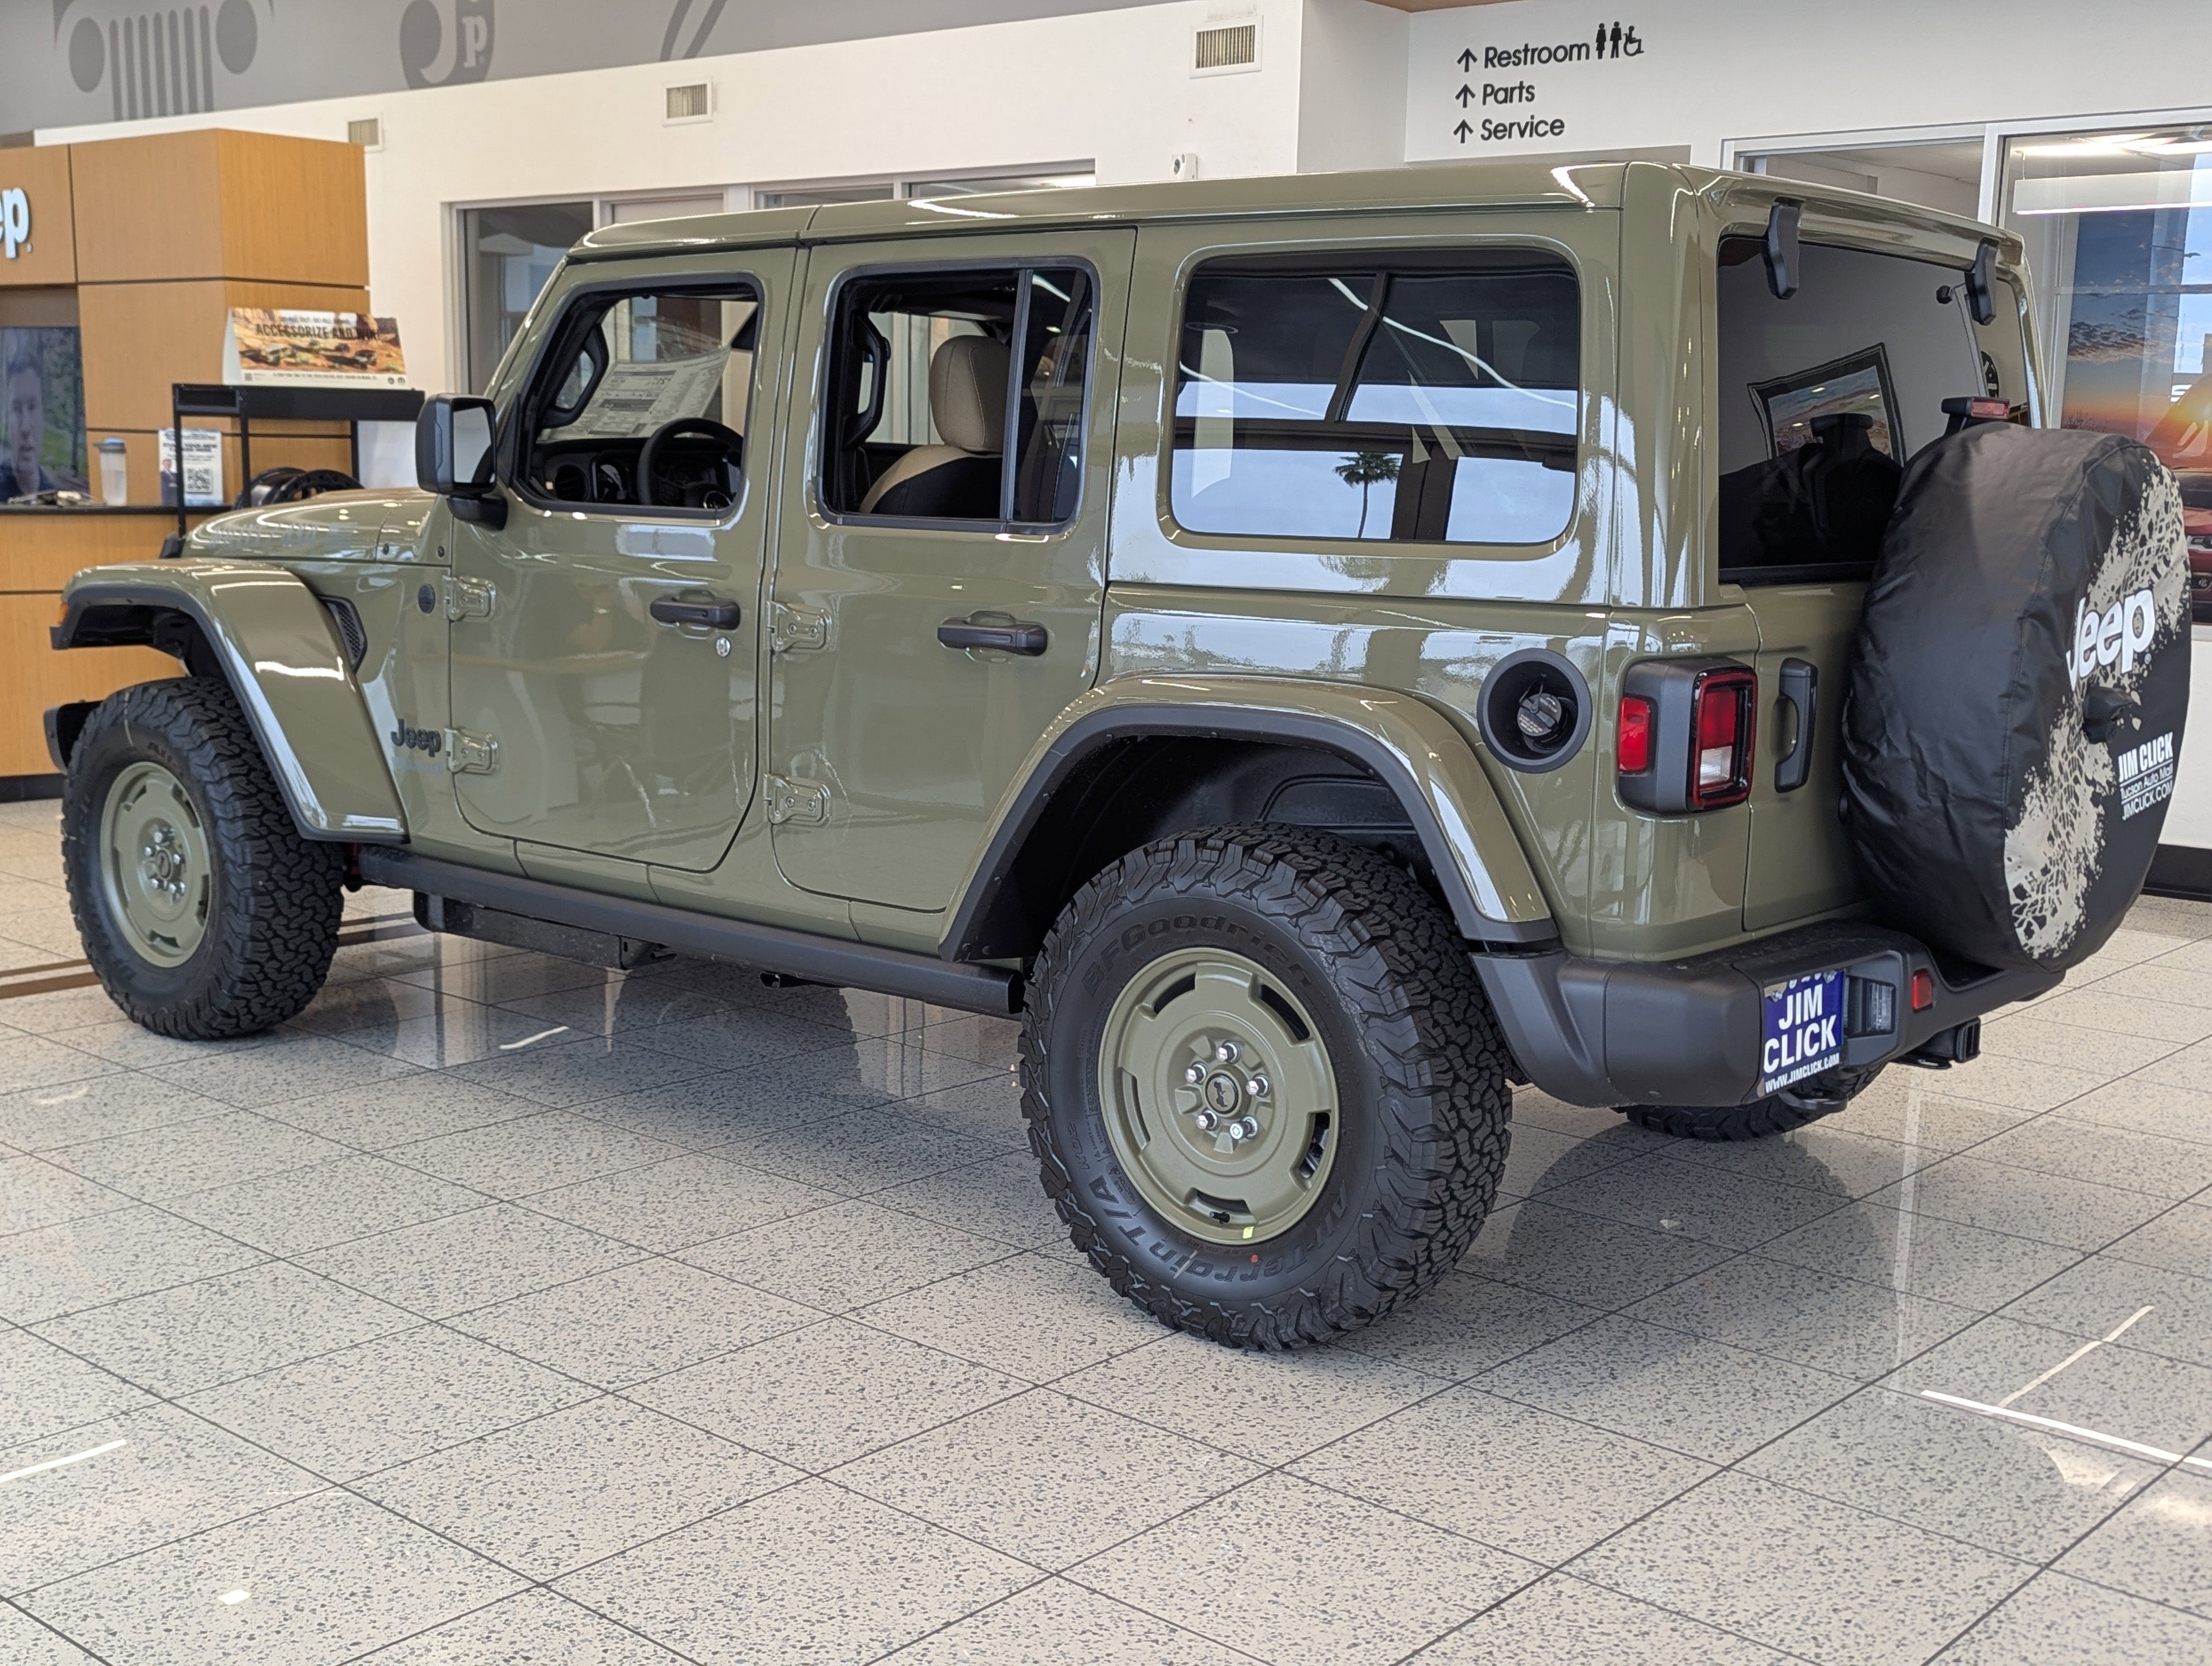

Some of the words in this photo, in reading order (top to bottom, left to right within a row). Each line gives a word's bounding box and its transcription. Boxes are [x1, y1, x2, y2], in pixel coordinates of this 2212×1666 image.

[1484, 43, 1590, 68] Restroom
[1482, 81, 1535, 105] Parts
[1480, 114, 1565, 141] Service
[0, 187, 29, 258] p
[256, 323, 329, 339] ACCESSORIZE
[333, 327, 352, 339] AND
[2066, 589, 2156, 692] Jeep
[391, 719, 441, 757] Jeep
[2118, 748, 2138, 783] JIM
[2139, 732, 2173, 771] CLICK
[2120, 781, 2142, 800] Tucson
[2144, 772, 2159, 788] Auto
[2159, 762, 2173, 780] Mall
[2122, 779, 2173, 821] JIMCLICK.COM
[1082, 914, 1312, 997] BFGoodrich
[1778, 983, 1823, 1030] JIM
[1764, 1014, 1837, 1073] CLICK
[1765, 1052, 1840, 1093] WWW.JIMCLICK.COM
